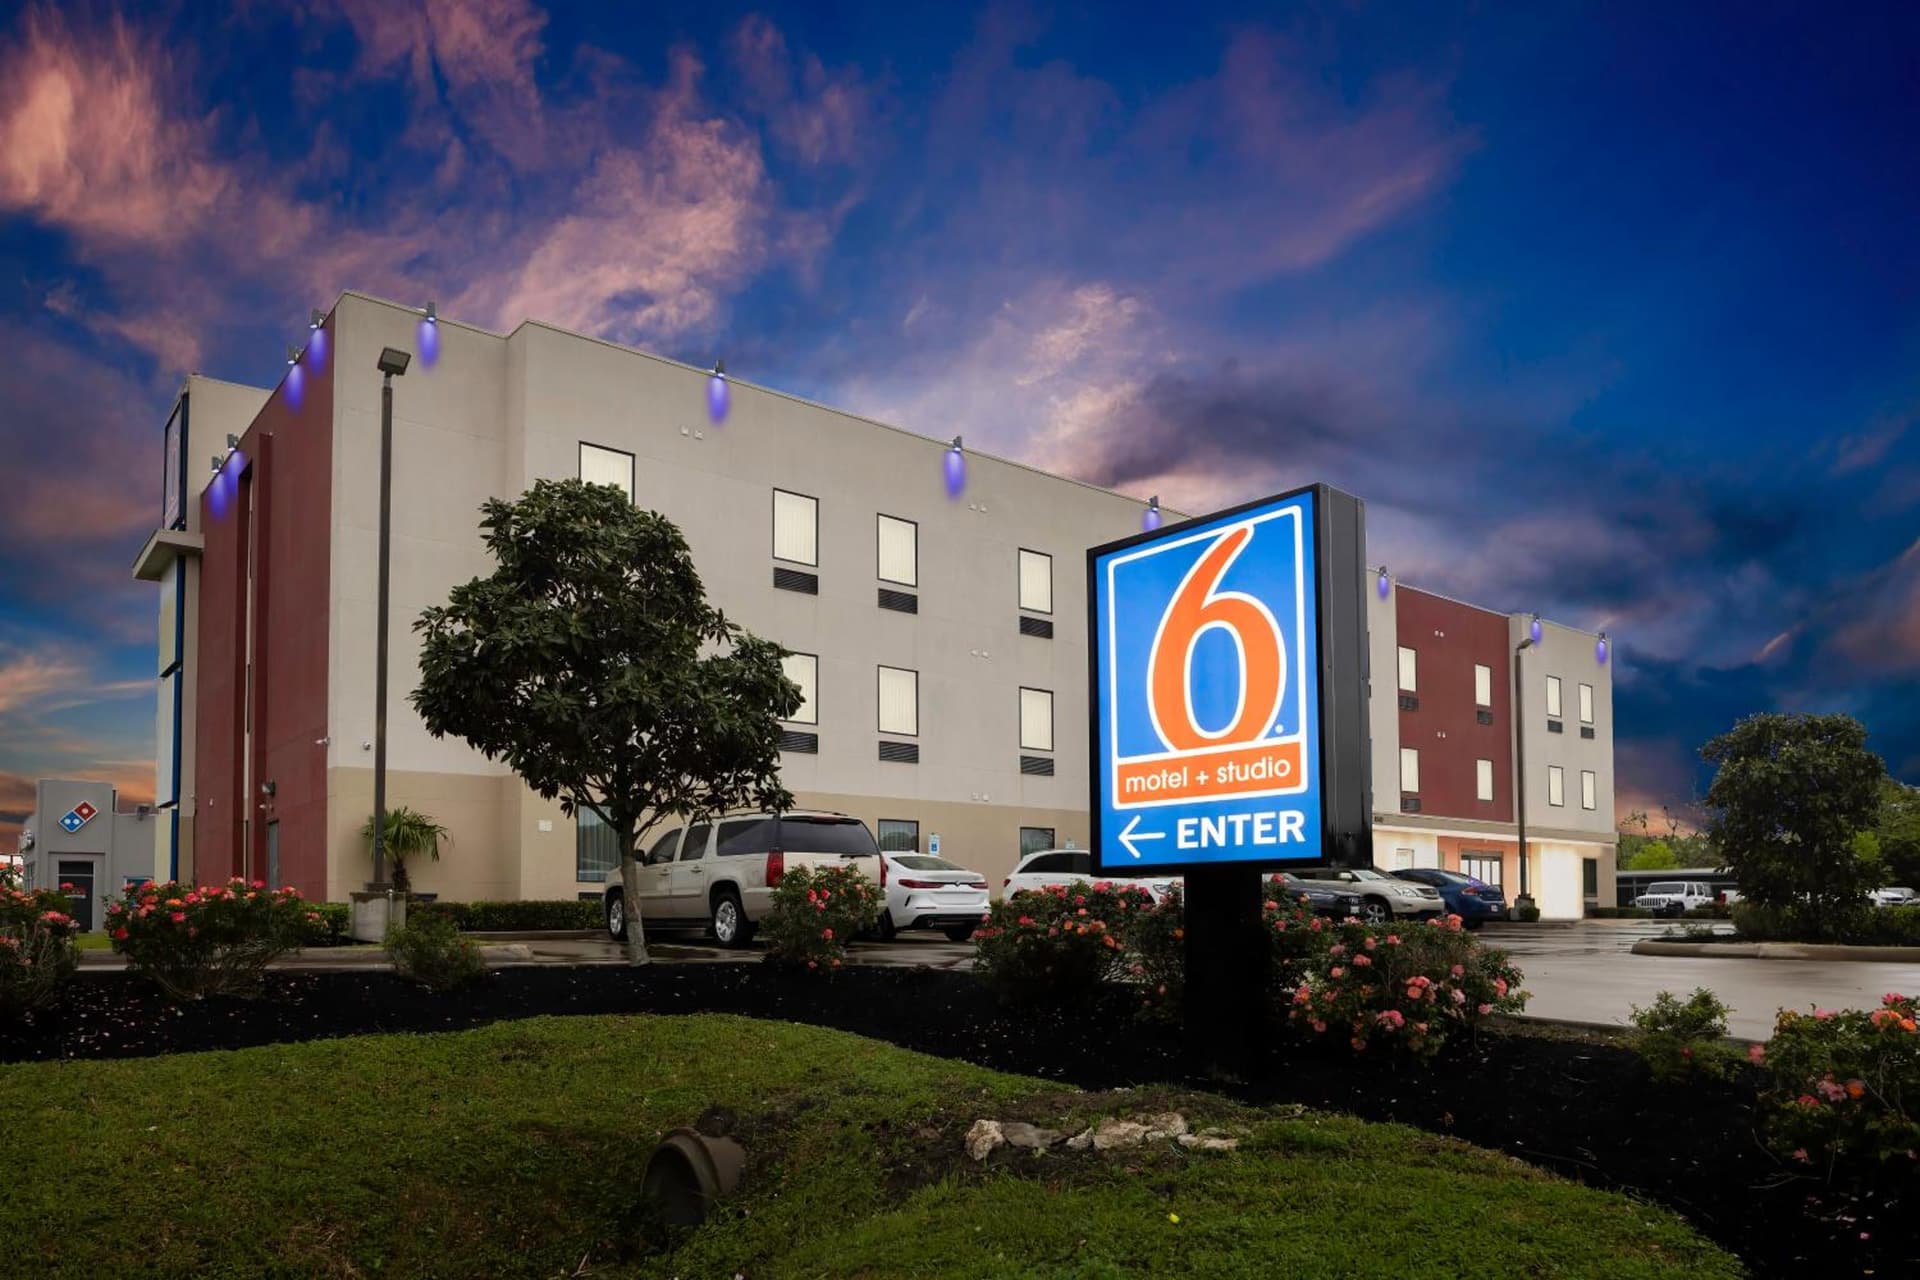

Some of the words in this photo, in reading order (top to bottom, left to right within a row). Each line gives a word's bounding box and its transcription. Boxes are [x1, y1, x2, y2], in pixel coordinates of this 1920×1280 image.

[1148, 522, 1287, 752] 6
[1125, 766, 1188, 793] motel
[1216, 756, 1291, 784] studio
[1177, 810, 1306, 849] ENTER
